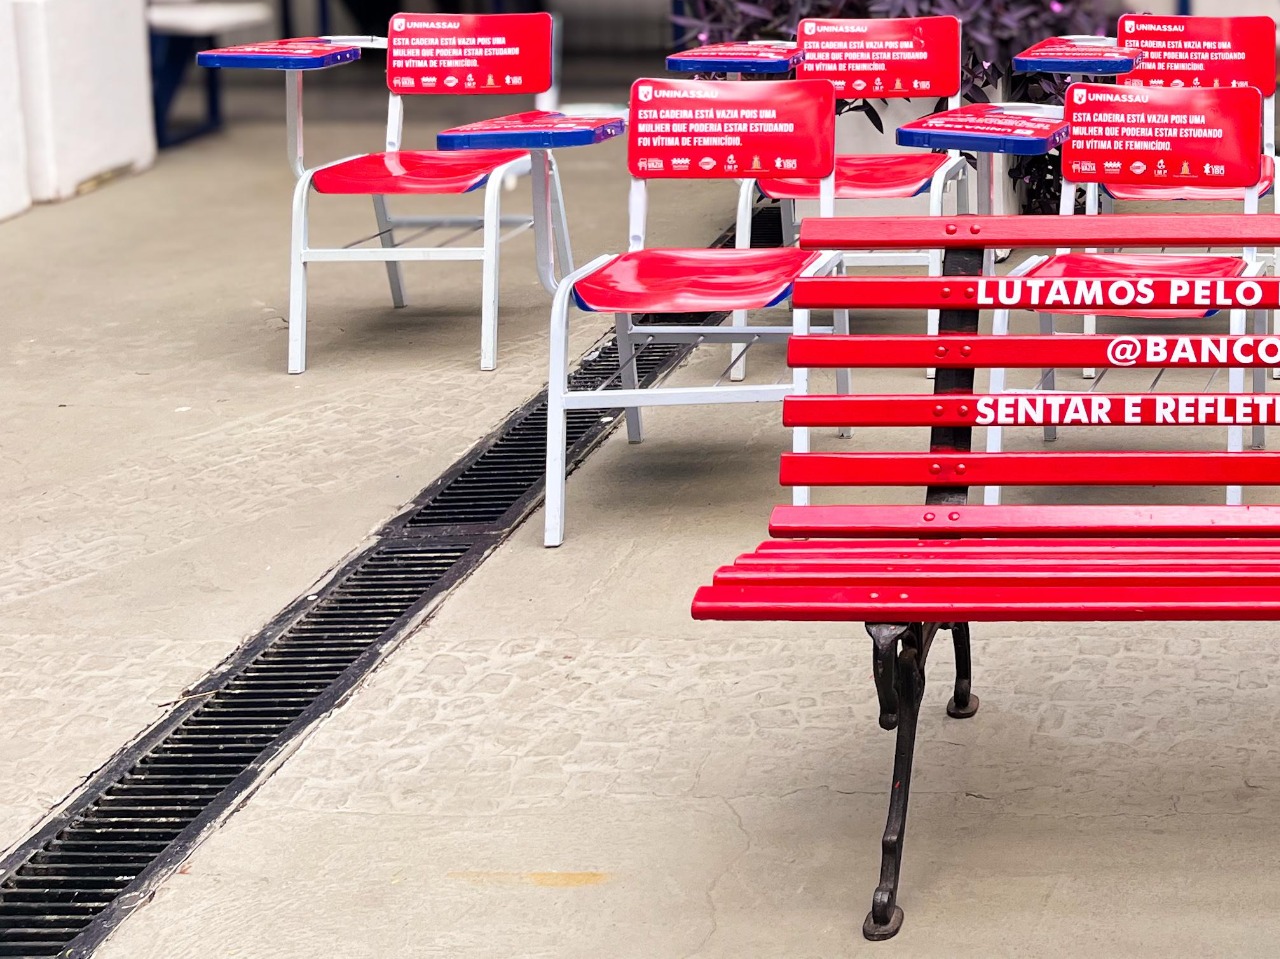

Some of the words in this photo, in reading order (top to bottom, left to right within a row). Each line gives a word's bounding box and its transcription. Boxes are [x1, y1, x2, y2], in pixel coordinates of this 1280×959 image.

[441, 36, 456, 45] ESTÁ
[849, 40, 864, 48] ESTÁ
[1125, 40, 1139, 48] ESTA
[1168, 40, 1182, 48] ESTÁ
[1184, 41, 1201, 49] VAZIA
[422, 48, 434, 56] QUE
[436, 48, 462, 56] PODERIA
[464, 48, 483, 56] ESTAR
[485, 47, 519, 55] ESTUDANDO
[831, 52, 843, 60] QUE
[845, 52, 870, 60] PODERIA
[872, 52, 891, 60] ESTAR
[405, 59, 428, 67] VÍTIMA
[439, 58, 479, 67] FEMINICÍDIO.
[804, 63, 814, 71] FOI
[816, 62, 837, 71] VÍTIMA
[839, 63, 846, 71] DE
[848, 62, 887, 71] FEMINICÍDIO.
[1167, 61, 1205, 70] FEMINICÍDIO.
[654, 90, 718, 98] UNINASSAU
[1088, 94, 1149, 103] UNINASSAU
[638, 110, 657, 119] ESTA
[660, 110, 693, 119] CADEIRA
[695, 108, 714, 119] ESTÁ
[716, 110, 738, 118] VAZIA
[740, 110, 757, 118] POIS
[760, 110, 776, 118] UMA
[1073, 113, 1091, 122] ESTA
[1093, 113, 1125, 123] CADEIRA
[1127, 112, 1145, 123] ESTÁ
[1147, 115, 1169, 123] VAZIA
[1171, 115, 1187, 124] POIS
[1189, 115, 1205, 124] UMA
[638, 123, 670, 132] MULHER
[672, 123, 686, 132] QUE
[689, 123, 722, 132] PODERIA
[724, 123, 748, 132] ESTAR
[750, 123, 794, 132] ESTUDANDO
[1073, 127, 1102, 136] MULHER
[1105, 127, 1119, 136] QUE
[1121, 128, 1152, 137] PODERIA
[1155, 128, 1178, 137] ESTAR
[1180, 128, 1222, 138] ESTUDANDO
[638, 138, 650, 146] FOI
[652, 136, 679, 146] VÍTIMA
[682, 137, 691, 146] DE
[694, 135, 742, 146] FEMINICÍDIO.
[1072, 141, 1084, 149] FOI
[1086, 139, 1112, 150] VÍTIMA
[1114, 141, 1123, 150] DE
[1126, 140, 1172, 151] FEMINICÍDIO.
[976, 280, 1154, 305] LUTAMOS
[1170, 280, 1263, 306] PELO
[975, 396, 1111, 425] SENTAR
[1125, 396, 1142, 423] E
